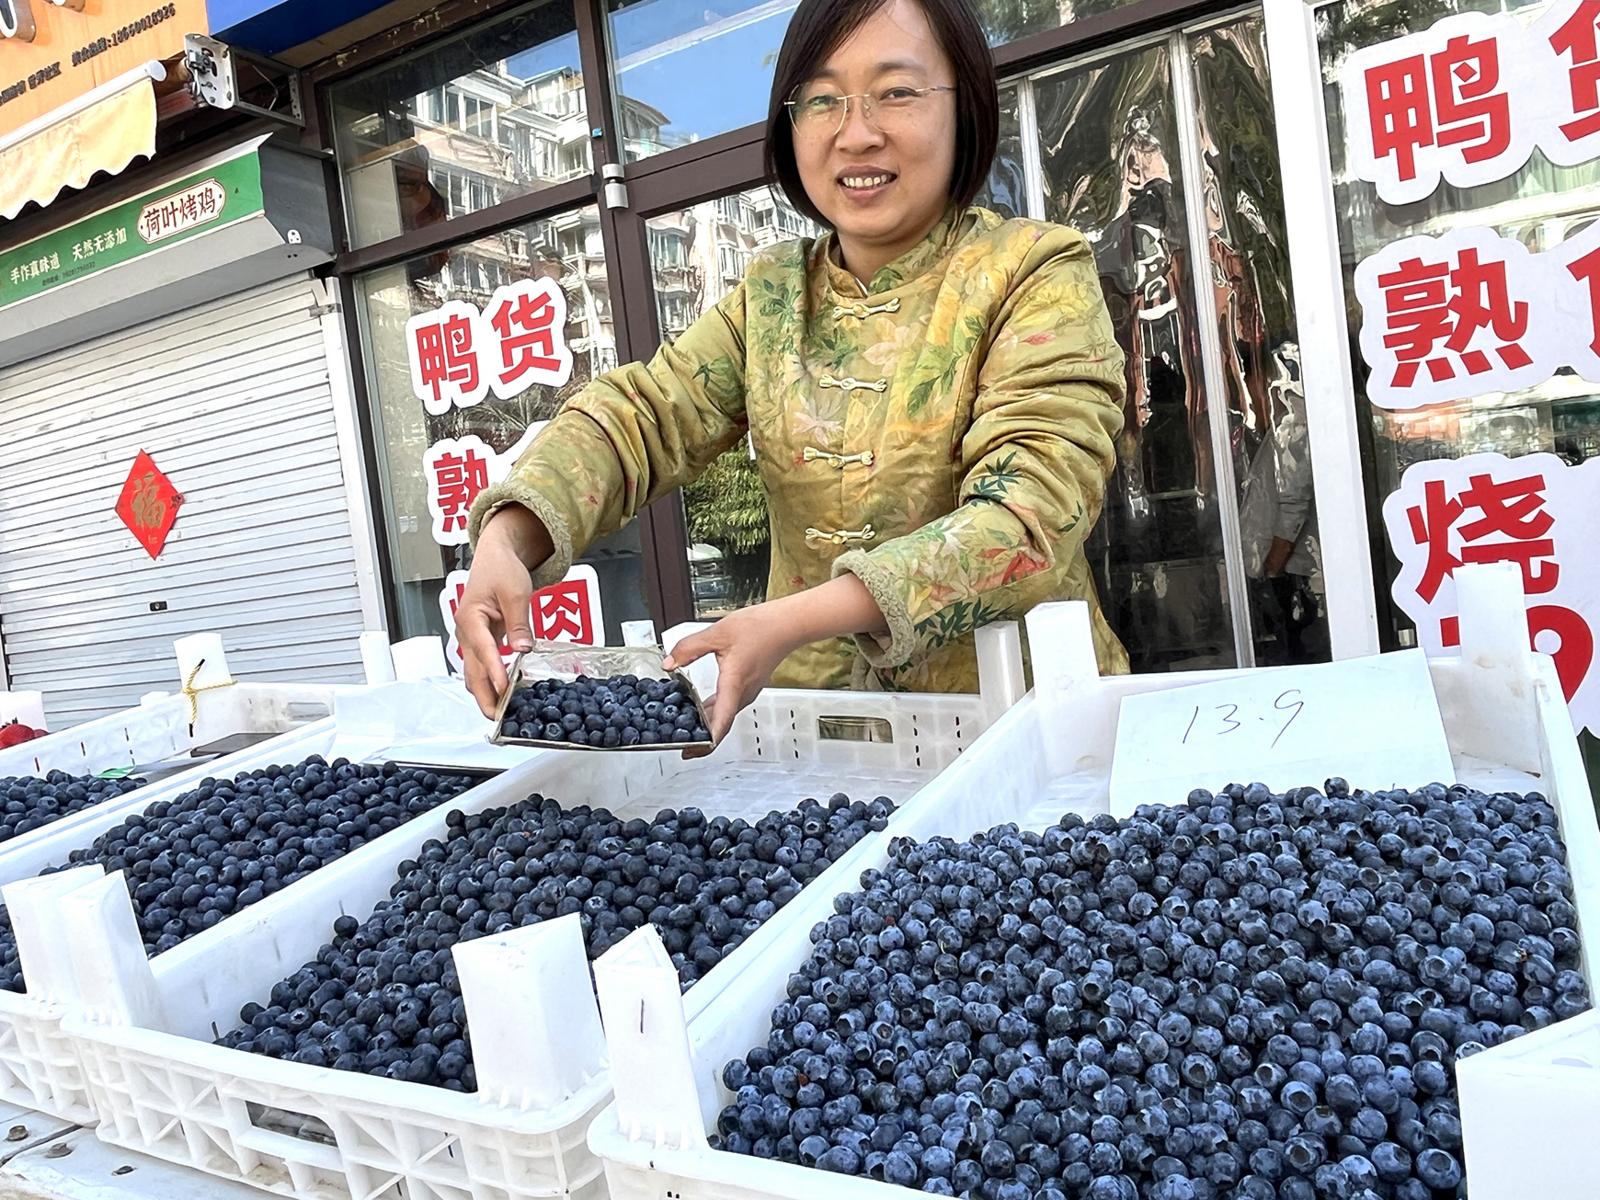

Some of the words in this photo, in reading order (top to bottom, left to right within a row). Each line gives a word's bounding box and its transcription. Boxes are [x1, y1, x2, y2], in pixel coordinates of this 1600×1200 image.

[144, 187, 216, 238] 荷叶烤鸡
[10, 252, 61, 285] 手作真味道
[72, 227, 128, 262] 天然无添加
[416, 292, 561, 401] 鸭货
[1378, 247, 1600, 388] 熟
[130, 471, 166, 529] 福
[433, 448, 517, 533] 熟
[1182, 688, 1305, 749] 13.9
